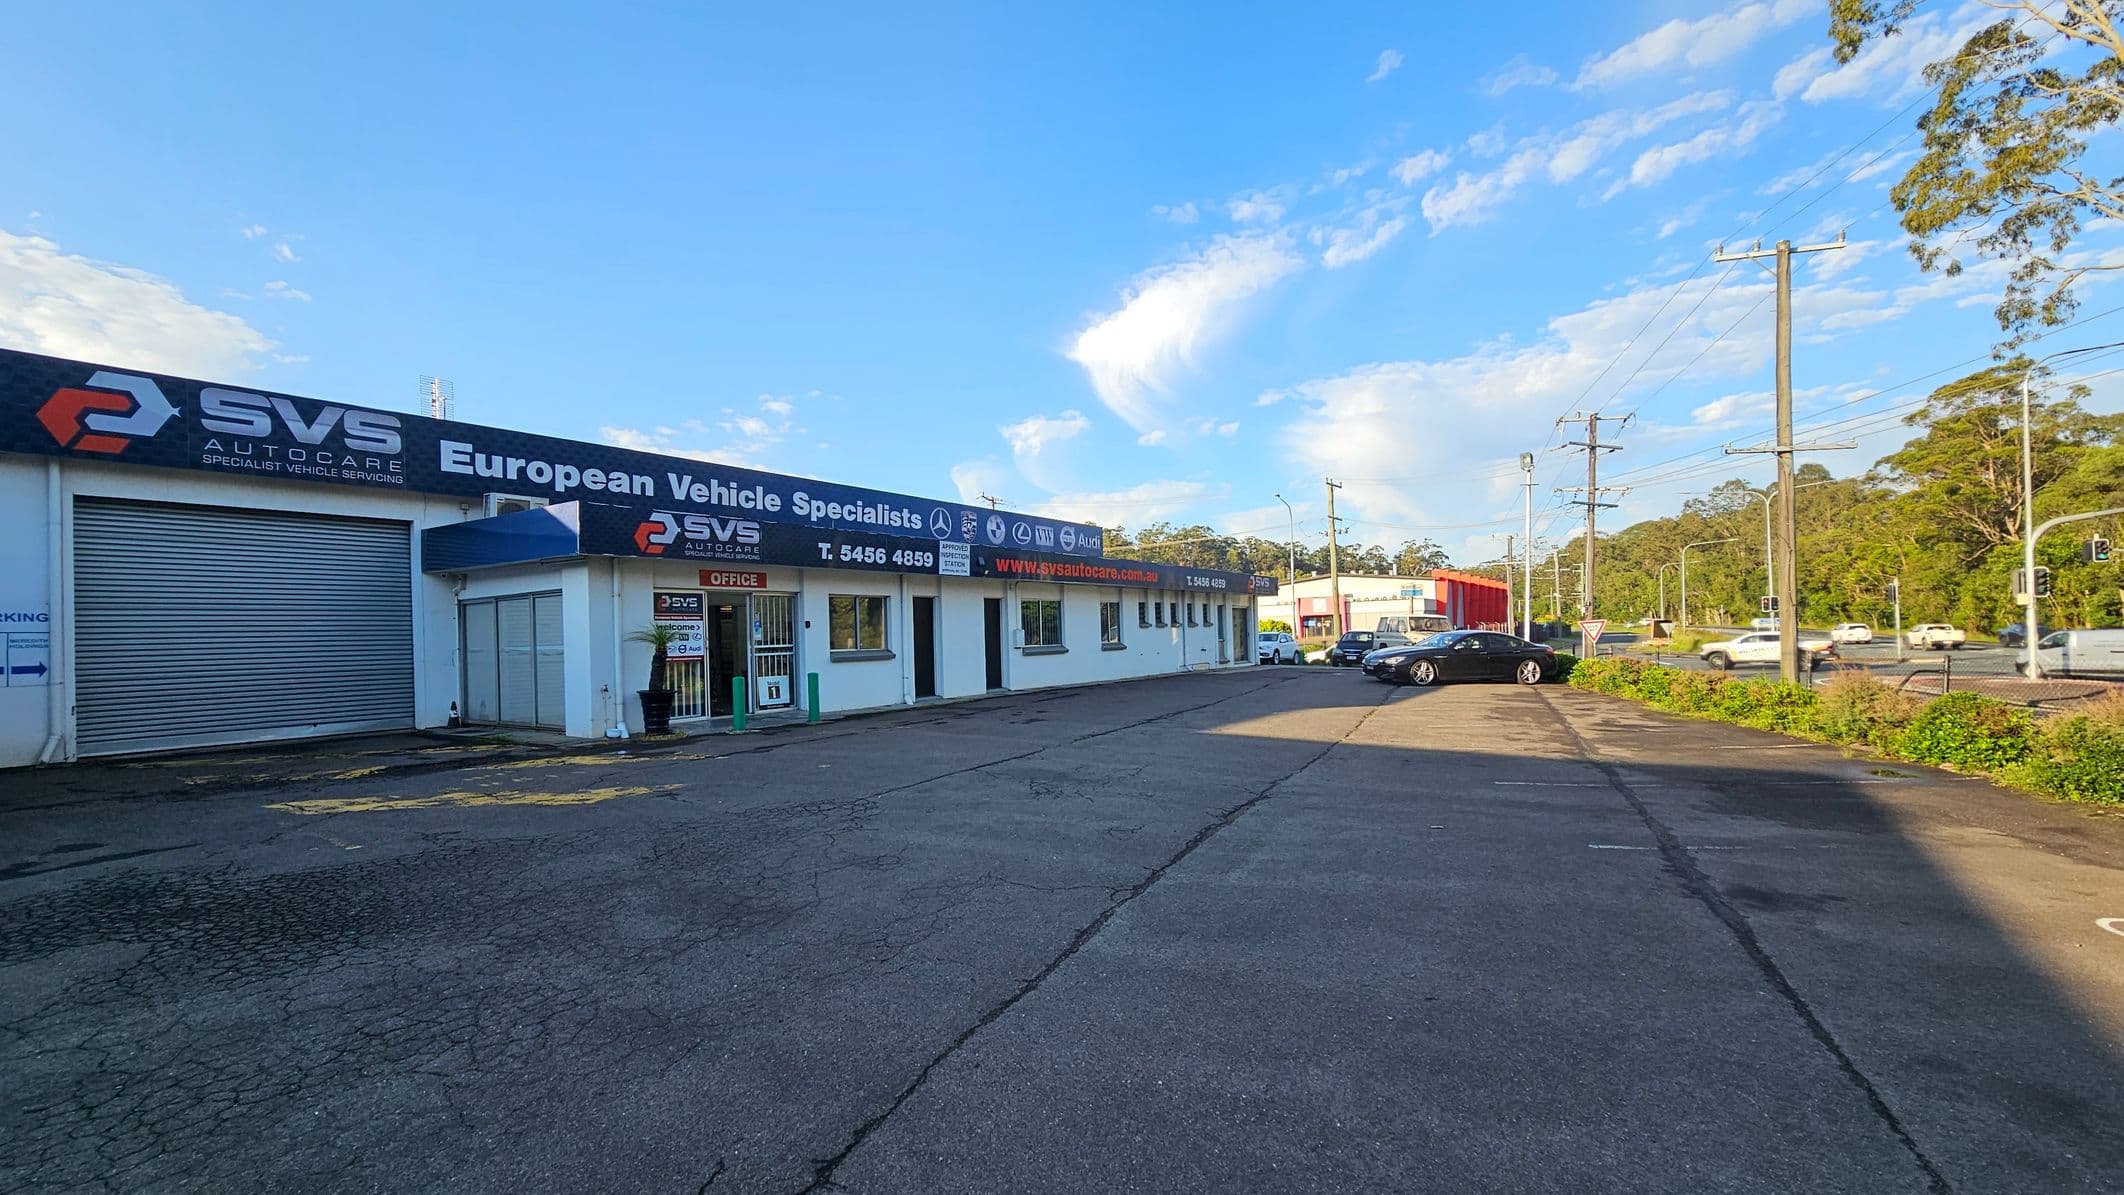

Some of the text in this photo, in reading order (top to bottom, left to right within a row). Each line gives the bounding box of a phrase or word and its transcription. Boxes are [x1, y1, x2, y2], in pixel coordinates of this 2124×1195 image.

[200, 388, 401, 455] SVS
[204, 438, 402, 472] AUTOCARE
[202, 454, 404, 484] SPECIALIST VEHICLE SERVICING
[440, 440, 923, 530] European Vehicle Specialists
[683, 515, 760, 544] SVS
[685, 542, 760, 553] AUTOCARE
[942, 543, 968, 552] APPROVED
[1078, 533, 1101, 550] Audi
[818, 543, 934, 568] T. 5456 4859
[944, 560, 966, 568] STATION
[710, 572, 758, 586] OFFICE
[996, 558, 1158, 583] www.svsautocare.com.au
[1255, 576, 1270, 588] SVS
[672, 598, 698, 607] SVS
[0, 612, 49, 623] KING
